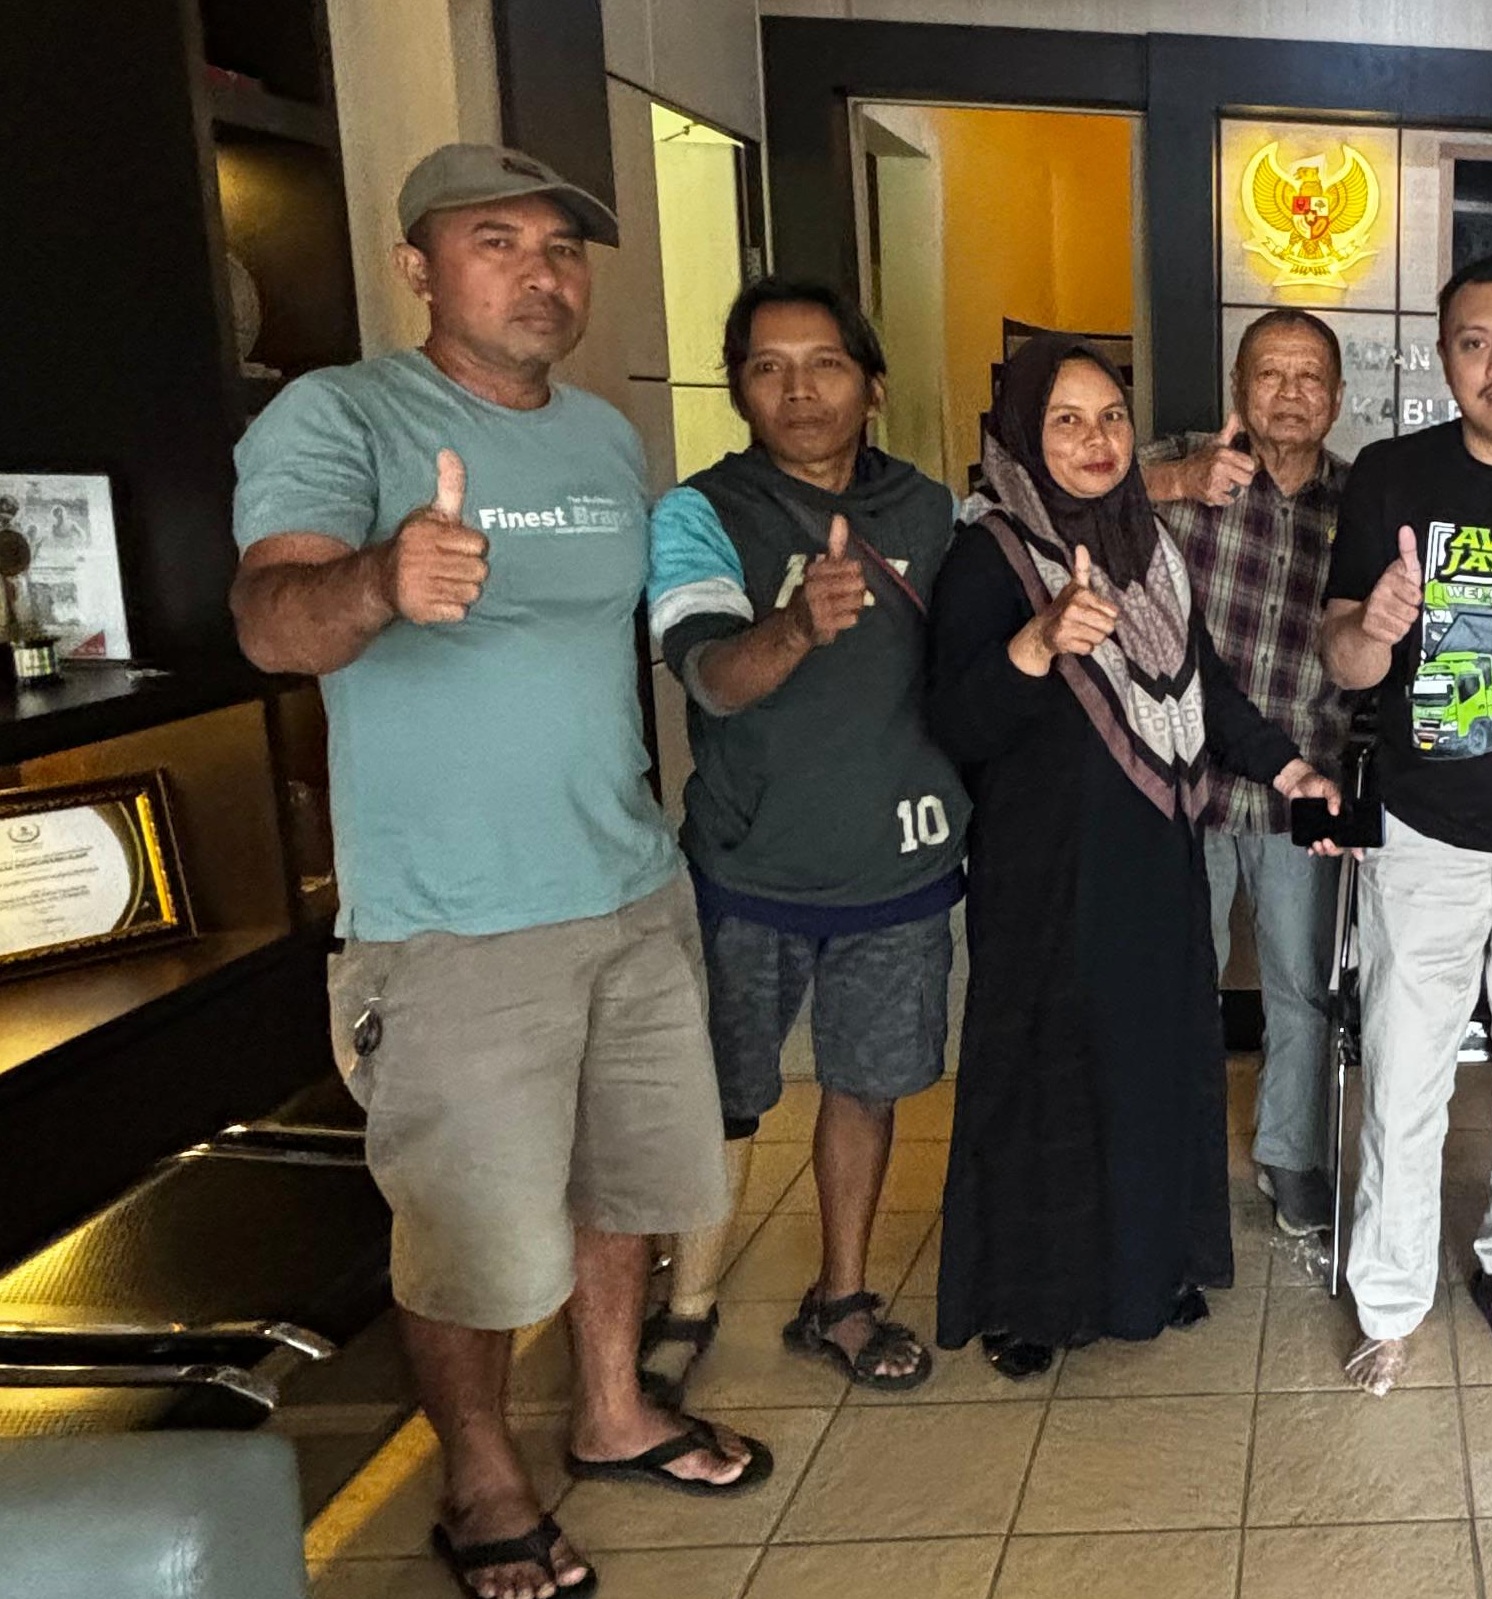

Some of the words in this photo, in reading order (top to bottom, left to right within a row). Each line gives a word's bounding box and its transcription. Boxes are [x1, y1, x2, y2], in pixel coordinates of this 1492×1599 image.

[1345, 341, 1430, 371] ADAN
[1351, 396, 1462, 426] KABUP
[479, 506, 568, 530] Finest
[897, 794, 949, 854] 10
